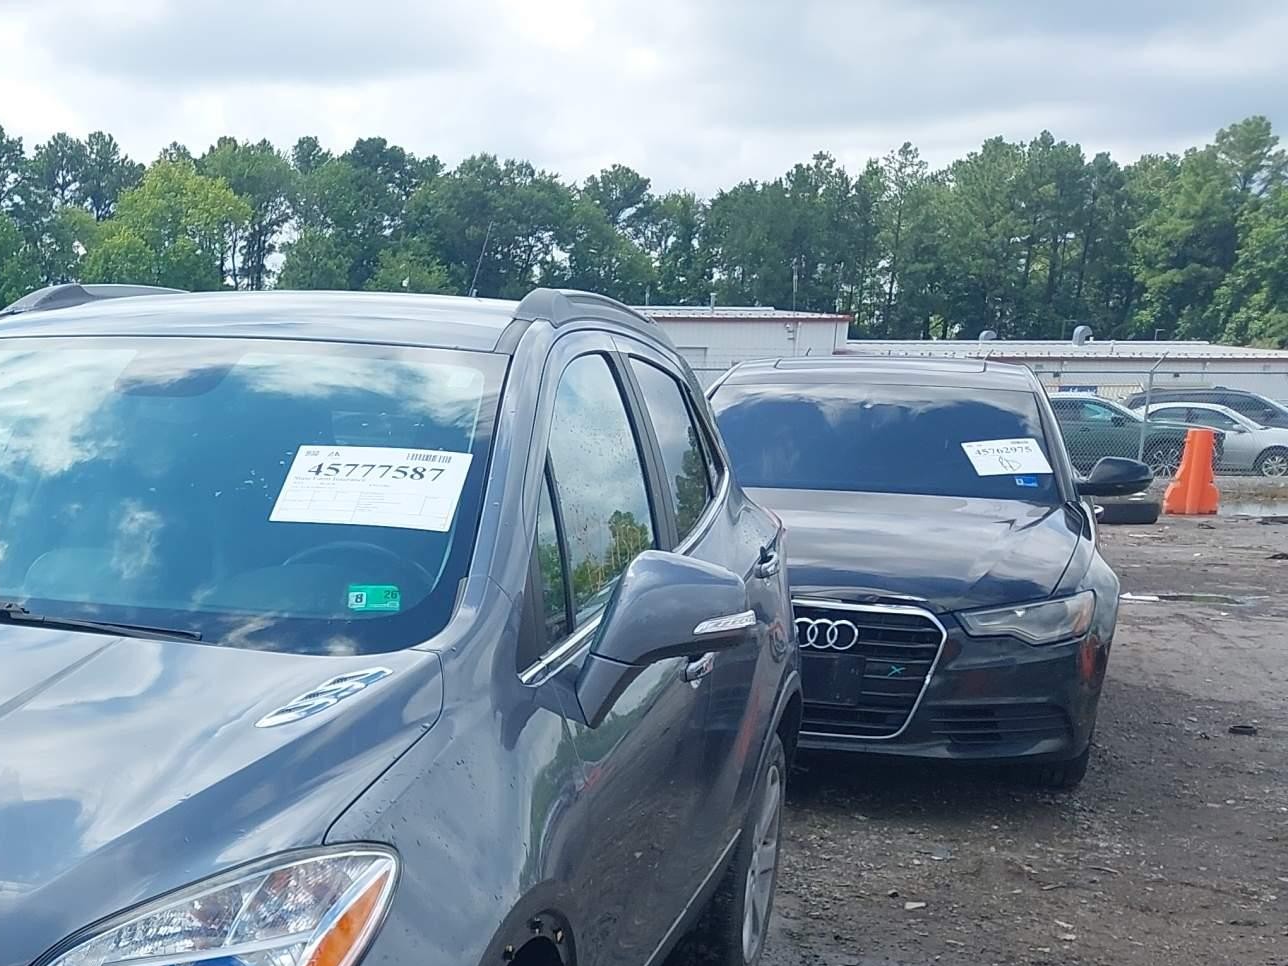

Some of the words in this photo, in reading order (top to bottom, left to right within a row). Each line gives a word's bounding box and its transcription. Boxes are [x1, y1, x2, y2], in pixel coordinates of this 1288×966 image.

[974, 446, 1033, 456] 45762975
[307, 462, 446, 482] 45777587
[354, 593, 364, 604] 8
[383, 590, 398, 600] 26
